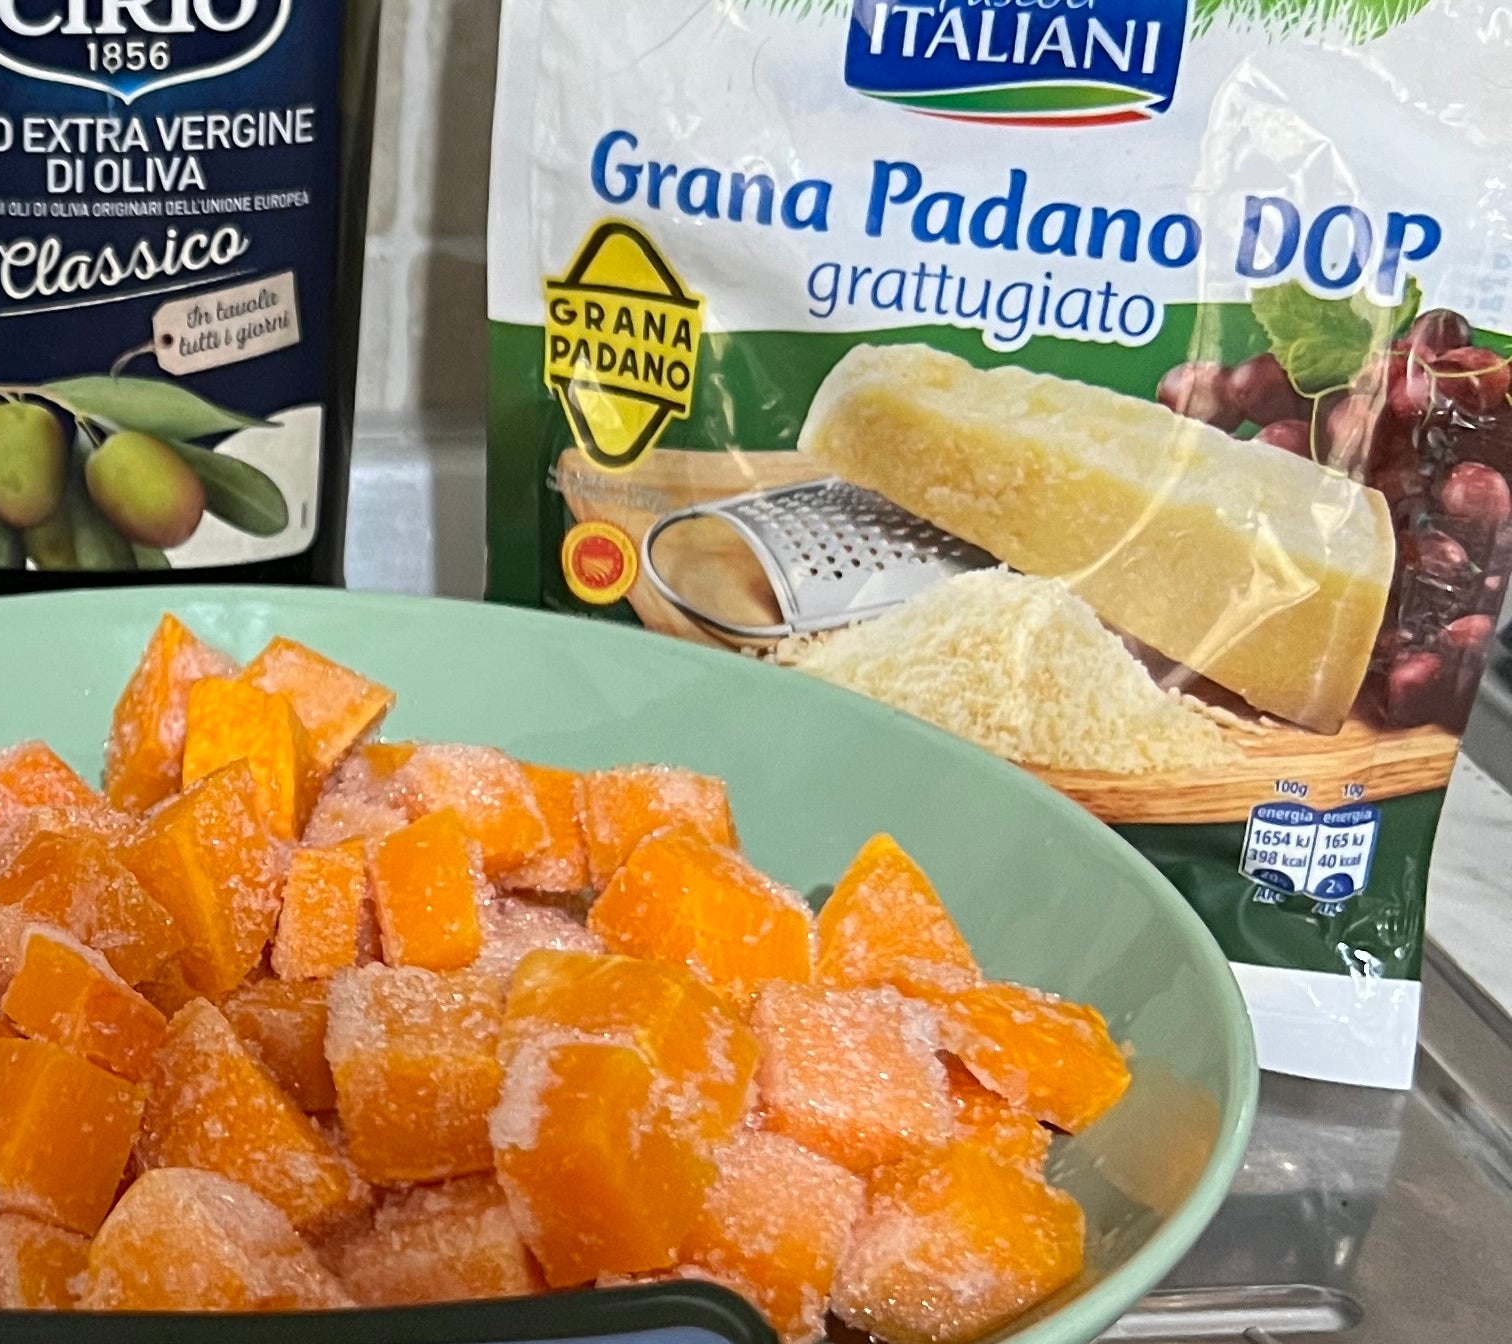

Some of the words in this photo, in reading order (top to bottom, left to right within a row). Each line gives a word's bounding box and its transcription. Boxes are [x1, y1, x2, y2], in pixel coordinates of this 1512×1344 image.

[869, 2, 1161, 75] ITALIANI
[86, 40, 171, 73] 1856
[23, 116, 149, 154] EXTRA
[156, 107, 315, 151] VERGINE
[46, 158, 85, 194] DI
[94, 156, 208, 194] OLIVA
[50, 201, 89, 217] OLIVA
[92, 199, 162, 217] ORIGINARI
[254, 189, 310, 213] EUROPEA
[590, 129, 833, 233] Grana
[865, 159, 1202, 269] Padano
[1234, 194, 1442, 297] DOP
[807, 261, 1156, 343] grattugiato
[179, 328, 221, 357] tutti
[236, 310, 290, 350] giorni
[549, 297, 693, 353] GRANA
[549, 335, 691, 392] PADANO
[1274, 779, 1308, 797] 100g
[1257, 807, 1314, 824] energia
[1322, 809, 1373, 824] energia
[1253, 830, 1291, 846] 1654
[1324, 832, 1349, 850] 165
[1247, 848, 1278, 866] 398
[1281, 851, 1308, 868] kcal
[1317, 853, 1337, 869] 40
